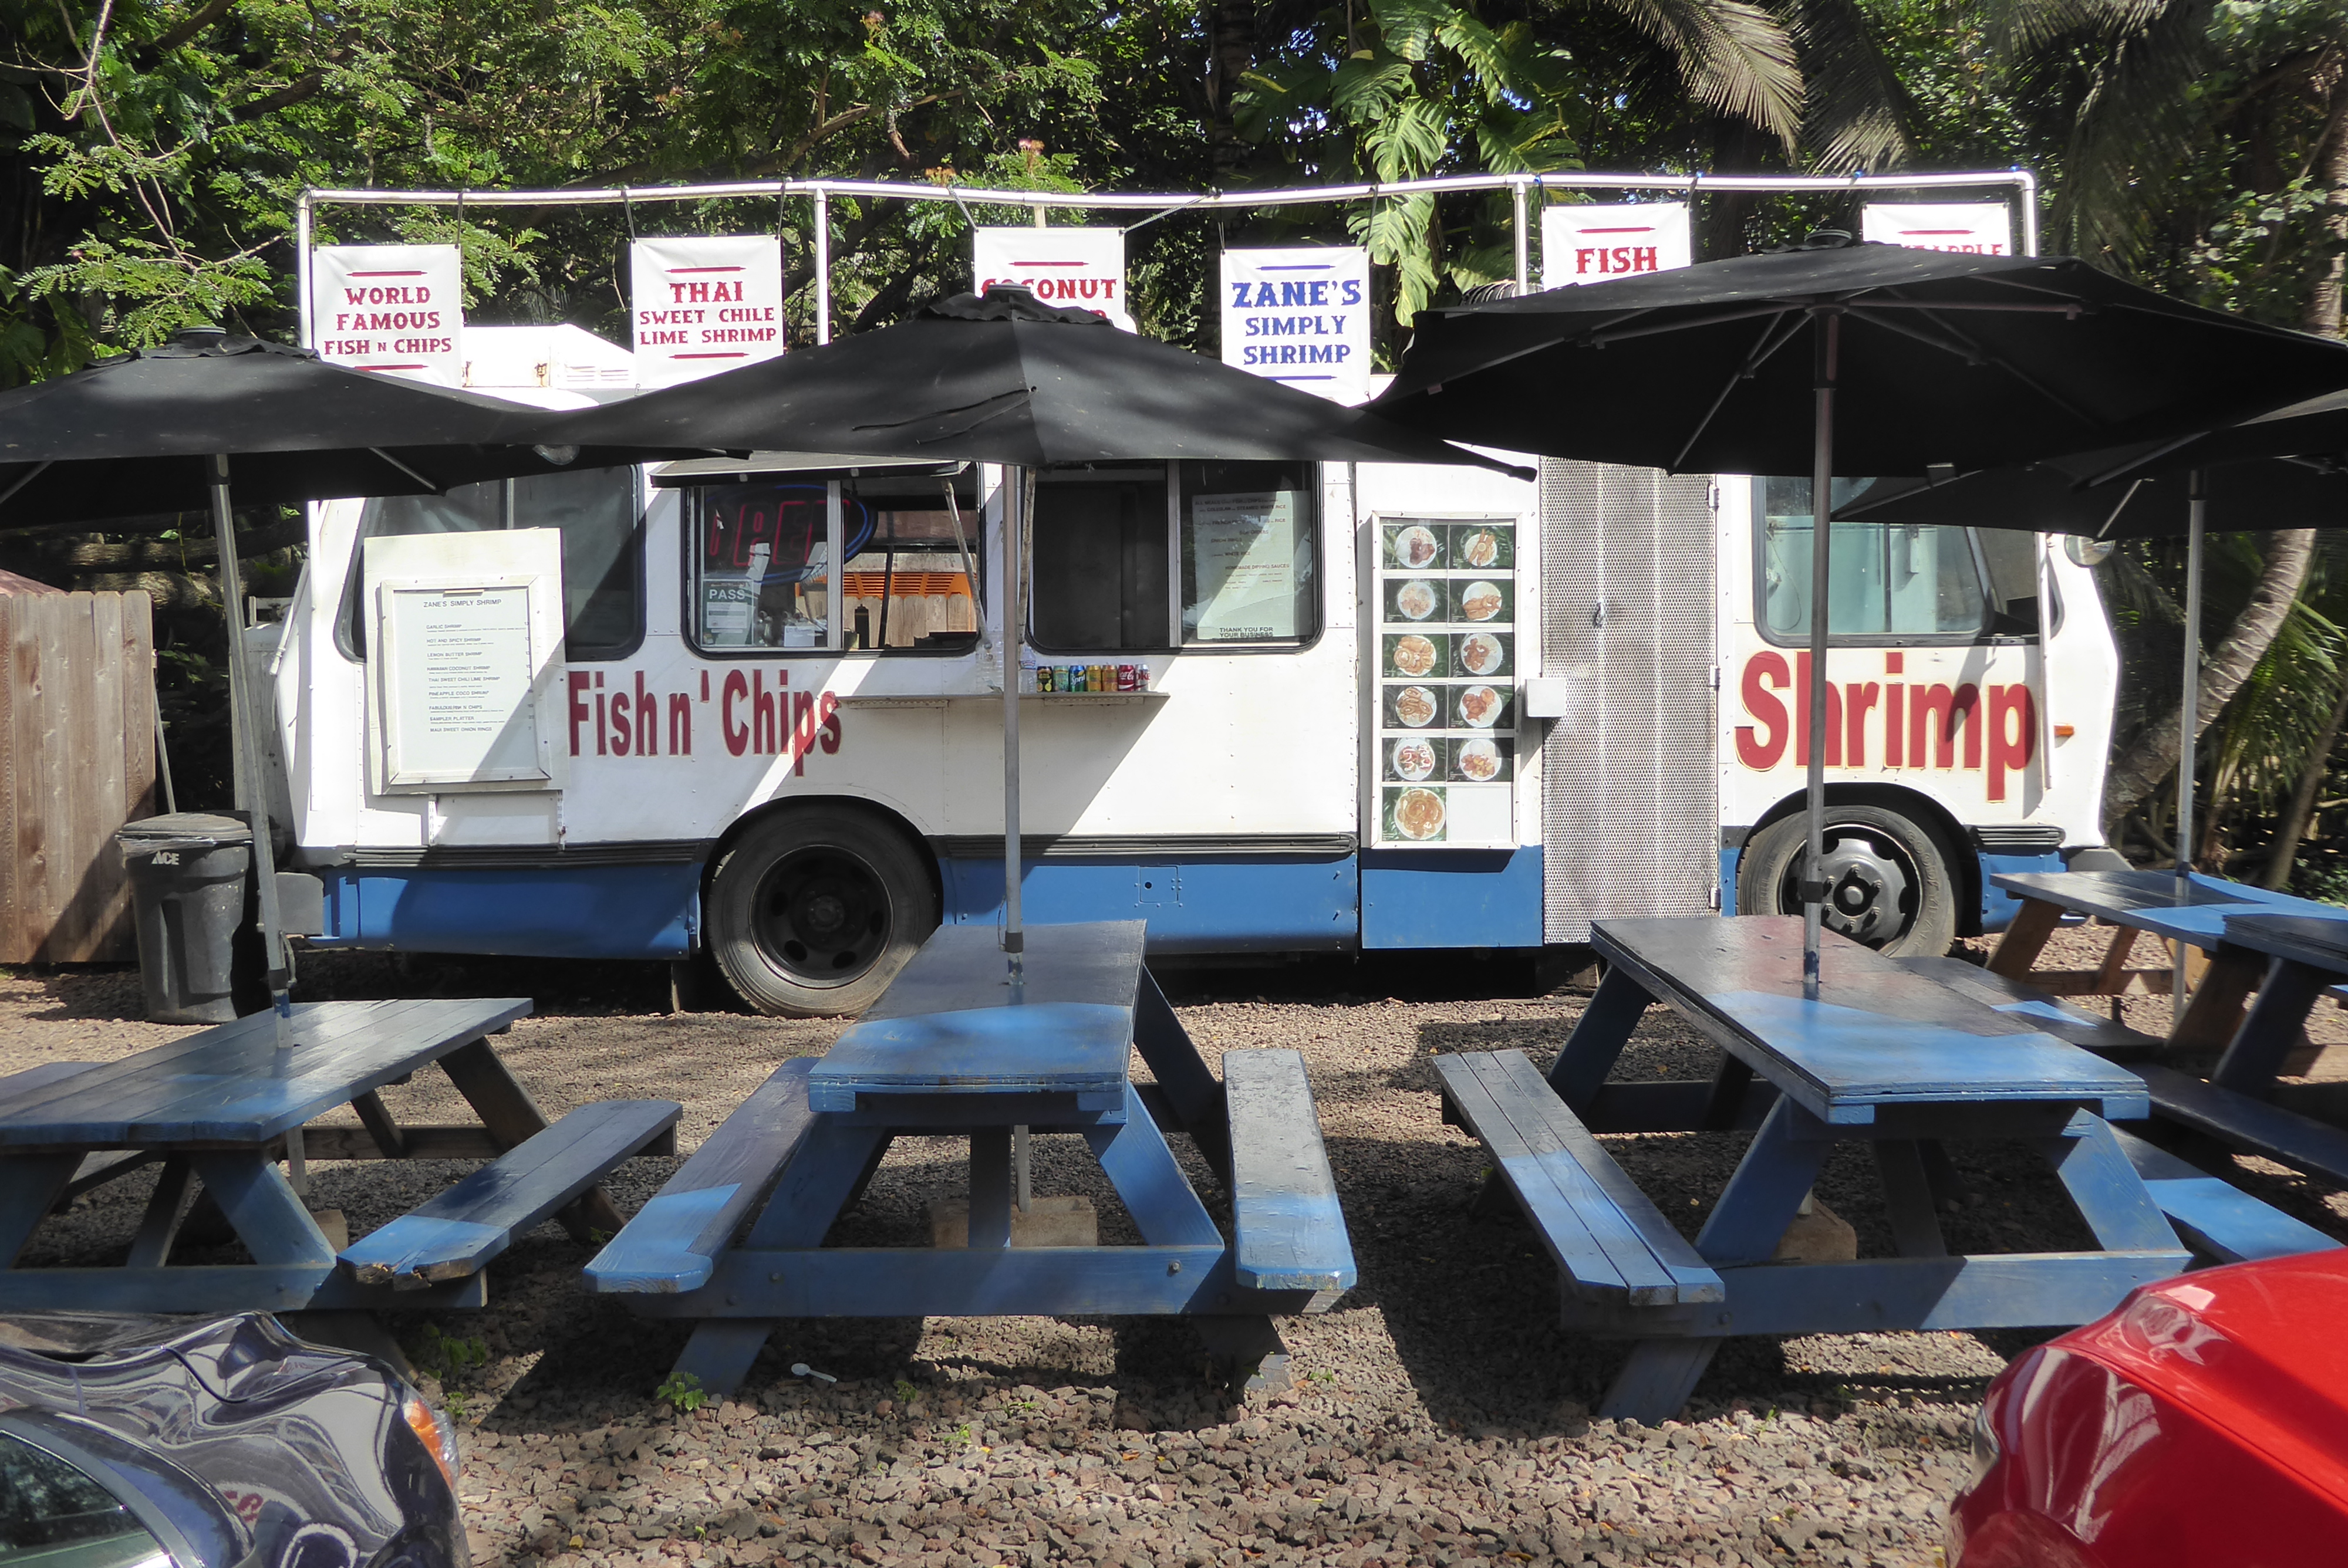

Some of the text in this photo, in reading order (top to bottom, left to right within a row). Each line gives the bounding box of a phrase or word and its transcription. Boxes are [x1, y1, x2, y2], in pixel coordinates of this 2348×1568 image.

[1575, 246, 1658, 273] FISH
[345, 286, 430, 305] WORLD
[670, 281, 743, 303] THAI
[1231, 280, 1362, 307] ZANE'S
[337, 312, 440, 330] FAMOUS
[639, 307, 775, 326] SWEET CHILE
[1245, 316, 1347, 336] SIMPLY
[325, 337, 452, 355] FISH N CHIPS
[640, 328, 777, 345] LIME SHRIMP
[1243, 344, 1351, 364] SHRIMP
[709, 589, 745, 599] PASS
[568, 670, 658, 756] Fish
[723, 668, 841, 776] Chips
[1734, 650, 2036, 802] Shrimp
[151, 851, 180, 866] ACE
